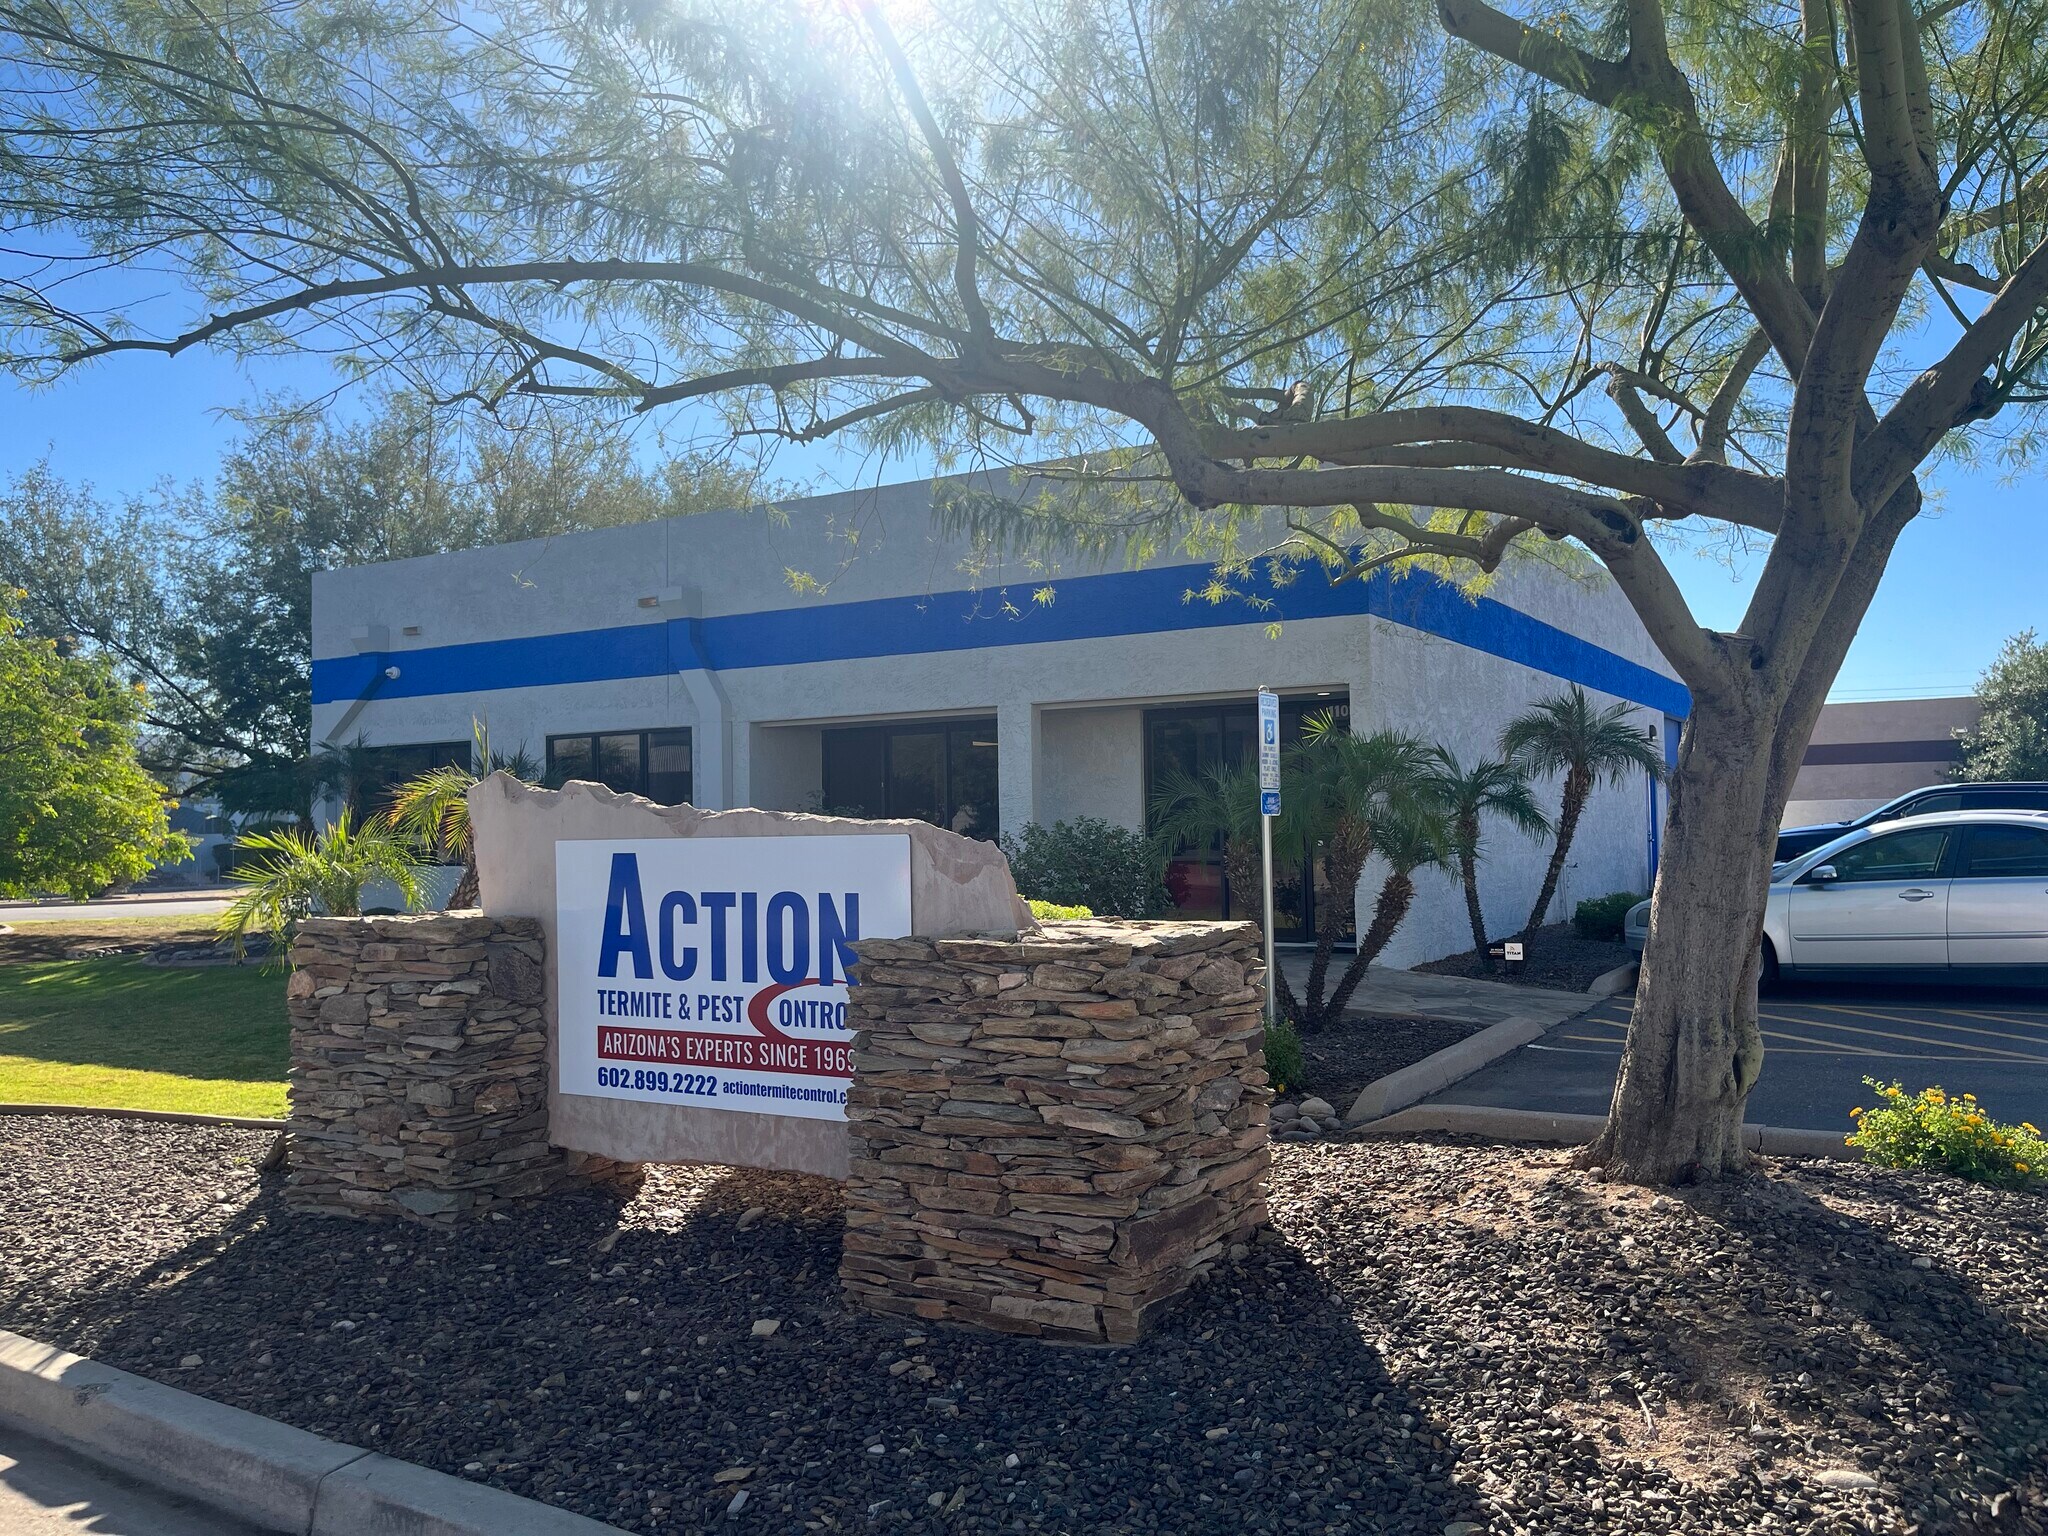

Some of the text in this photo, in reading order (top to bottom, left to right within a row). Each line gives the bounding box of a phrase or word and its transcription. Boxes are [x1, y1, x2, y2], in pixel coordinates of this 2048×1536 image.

[1261, 707, 1277, 719] PARKING
[1329, 705, 1349, 718] 110
[598, 852, 860, 986] ACTION
[597, 989, 672, 1019] TERMITE
[678, 993, 691, 1021] &
[697, 994, 744, 1023] PEST
[603, 1031, 681, 1059] ARIZONA'S
[686, 1037, 754, 1065] EXPERTS
[759, 1042, 808, 1069] SINCE
[597, 1066, 847, 1105] 602.899.2222 actiontermitecontrol.c
